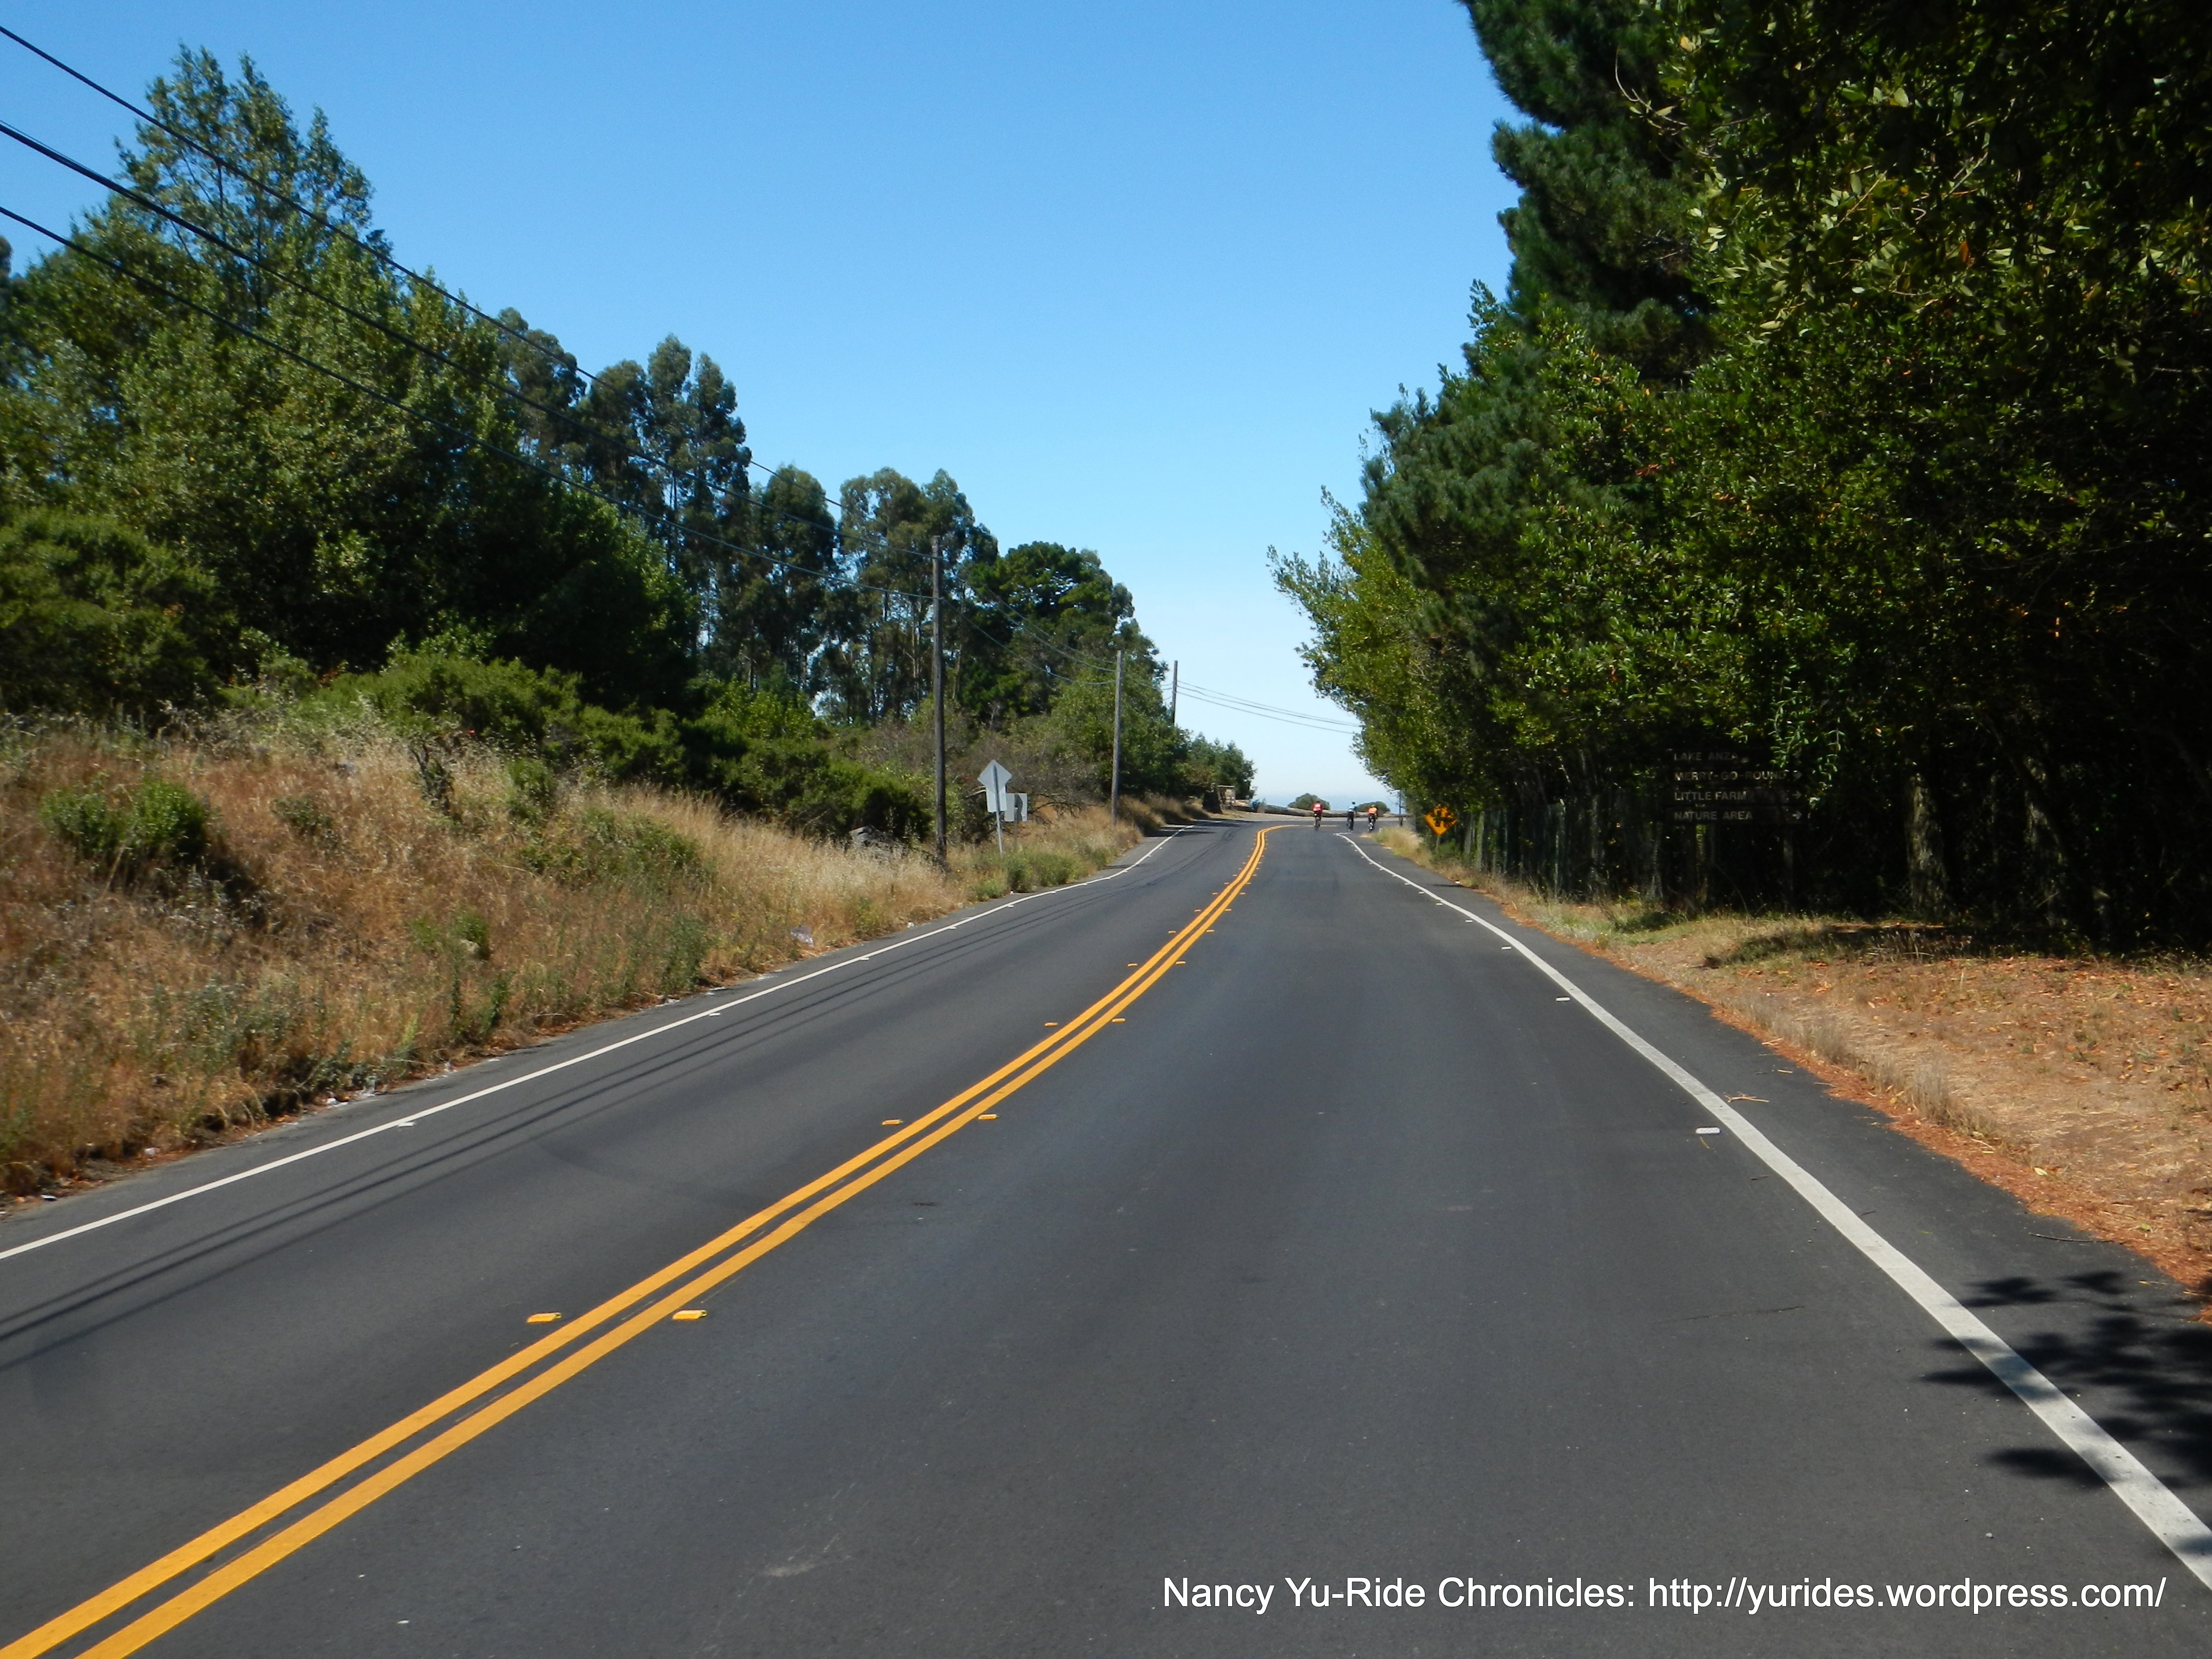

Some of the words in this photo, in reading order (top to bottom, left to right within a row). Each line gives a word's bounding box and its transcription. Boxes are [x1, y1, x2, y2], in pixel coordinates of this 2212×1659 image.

[1674, 752, 1702, 761] LAKE
[1708, 751, 1738, 761] ANZA
[1674, 771, 1787, 781] MERRY-GO-ROUND
[1674, 791, 1712, 801] LITTLE
[1715, 791, 1747, 800] FARM
[1674, 811, 1718, 820] NATURE
[1722, 810, 1753, 820] AREA
